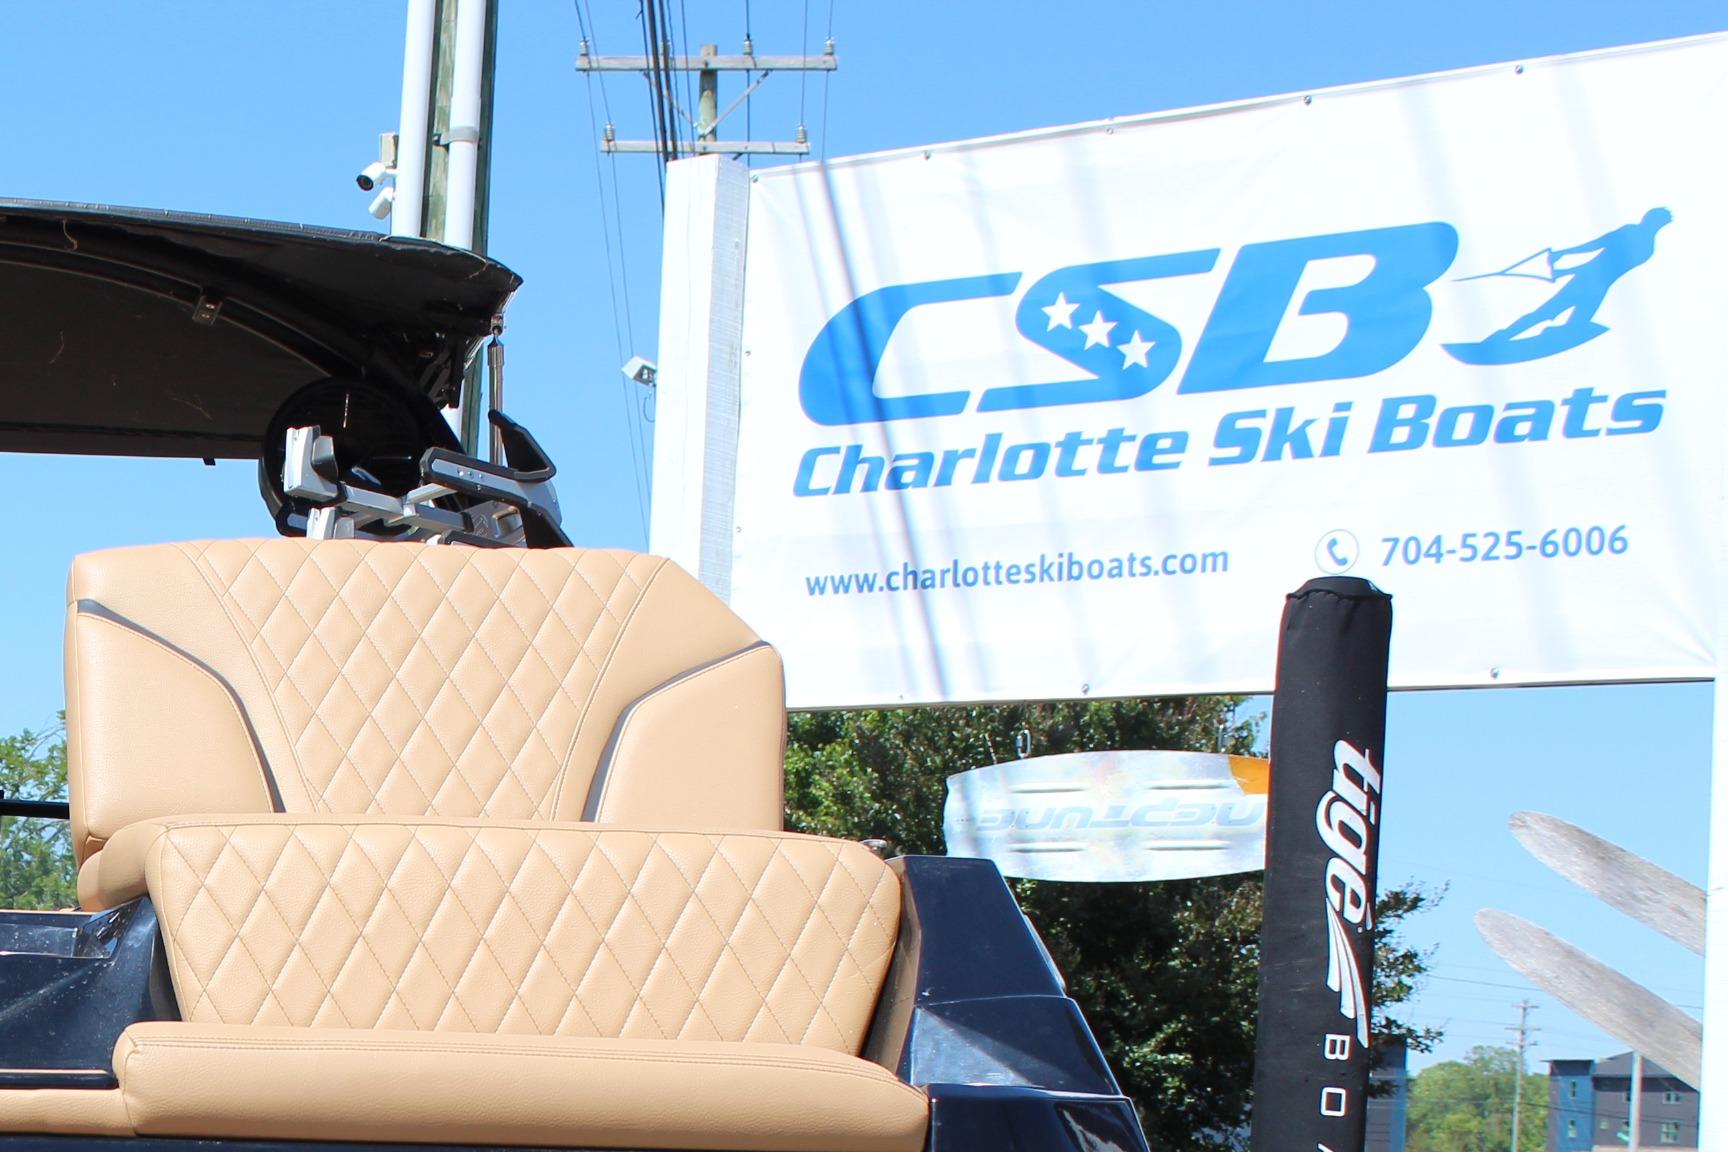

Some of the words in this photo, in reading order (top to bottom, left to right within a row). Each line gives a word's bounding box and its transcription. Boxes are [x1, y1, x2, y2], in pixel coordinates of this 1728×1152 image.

[799, 221, 1459, 427] CSB
[792, 425, 1190, 497] Charlotte
[1207, 400, 1353, 466] Ski
[1367, 384, 1668, 453] Boats
[805, 548, 1230, 597] www.charlotteskiboats.com
[1379, 524, 1630, 570] 704-525-6006
